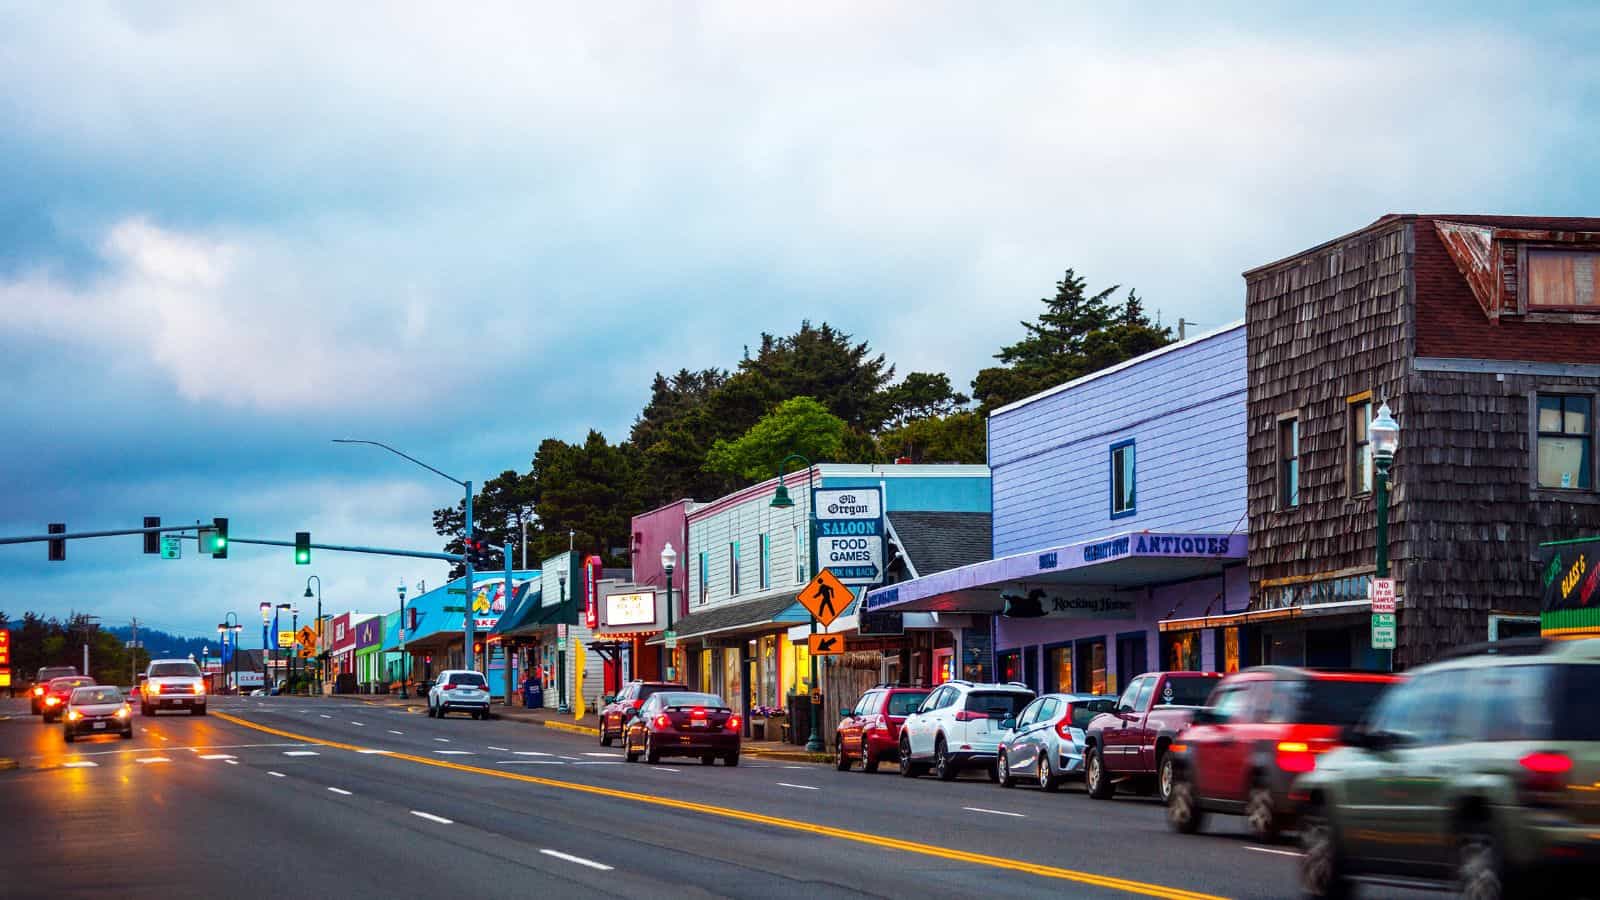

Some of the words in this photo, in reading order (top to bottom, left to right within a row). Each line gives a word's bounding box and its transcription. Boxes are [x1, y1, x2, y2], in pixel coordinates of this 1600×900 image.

[839, 494, 856, 504] Old
[827, 503, 868, 516] Oregon
[822, 521, 875, 535] SALOON
[831, 538, 867, 550] FOOD
[1135, 535, 1230, 554] ANTIQUES
[829, 551, 870, 562] GAMES
[829, 567, 843, 577] ARK
[845, 567, 854, 577] IN
[856, 566, 875, 577] BACK
[1052, 597, 1098, 612] Rocking
